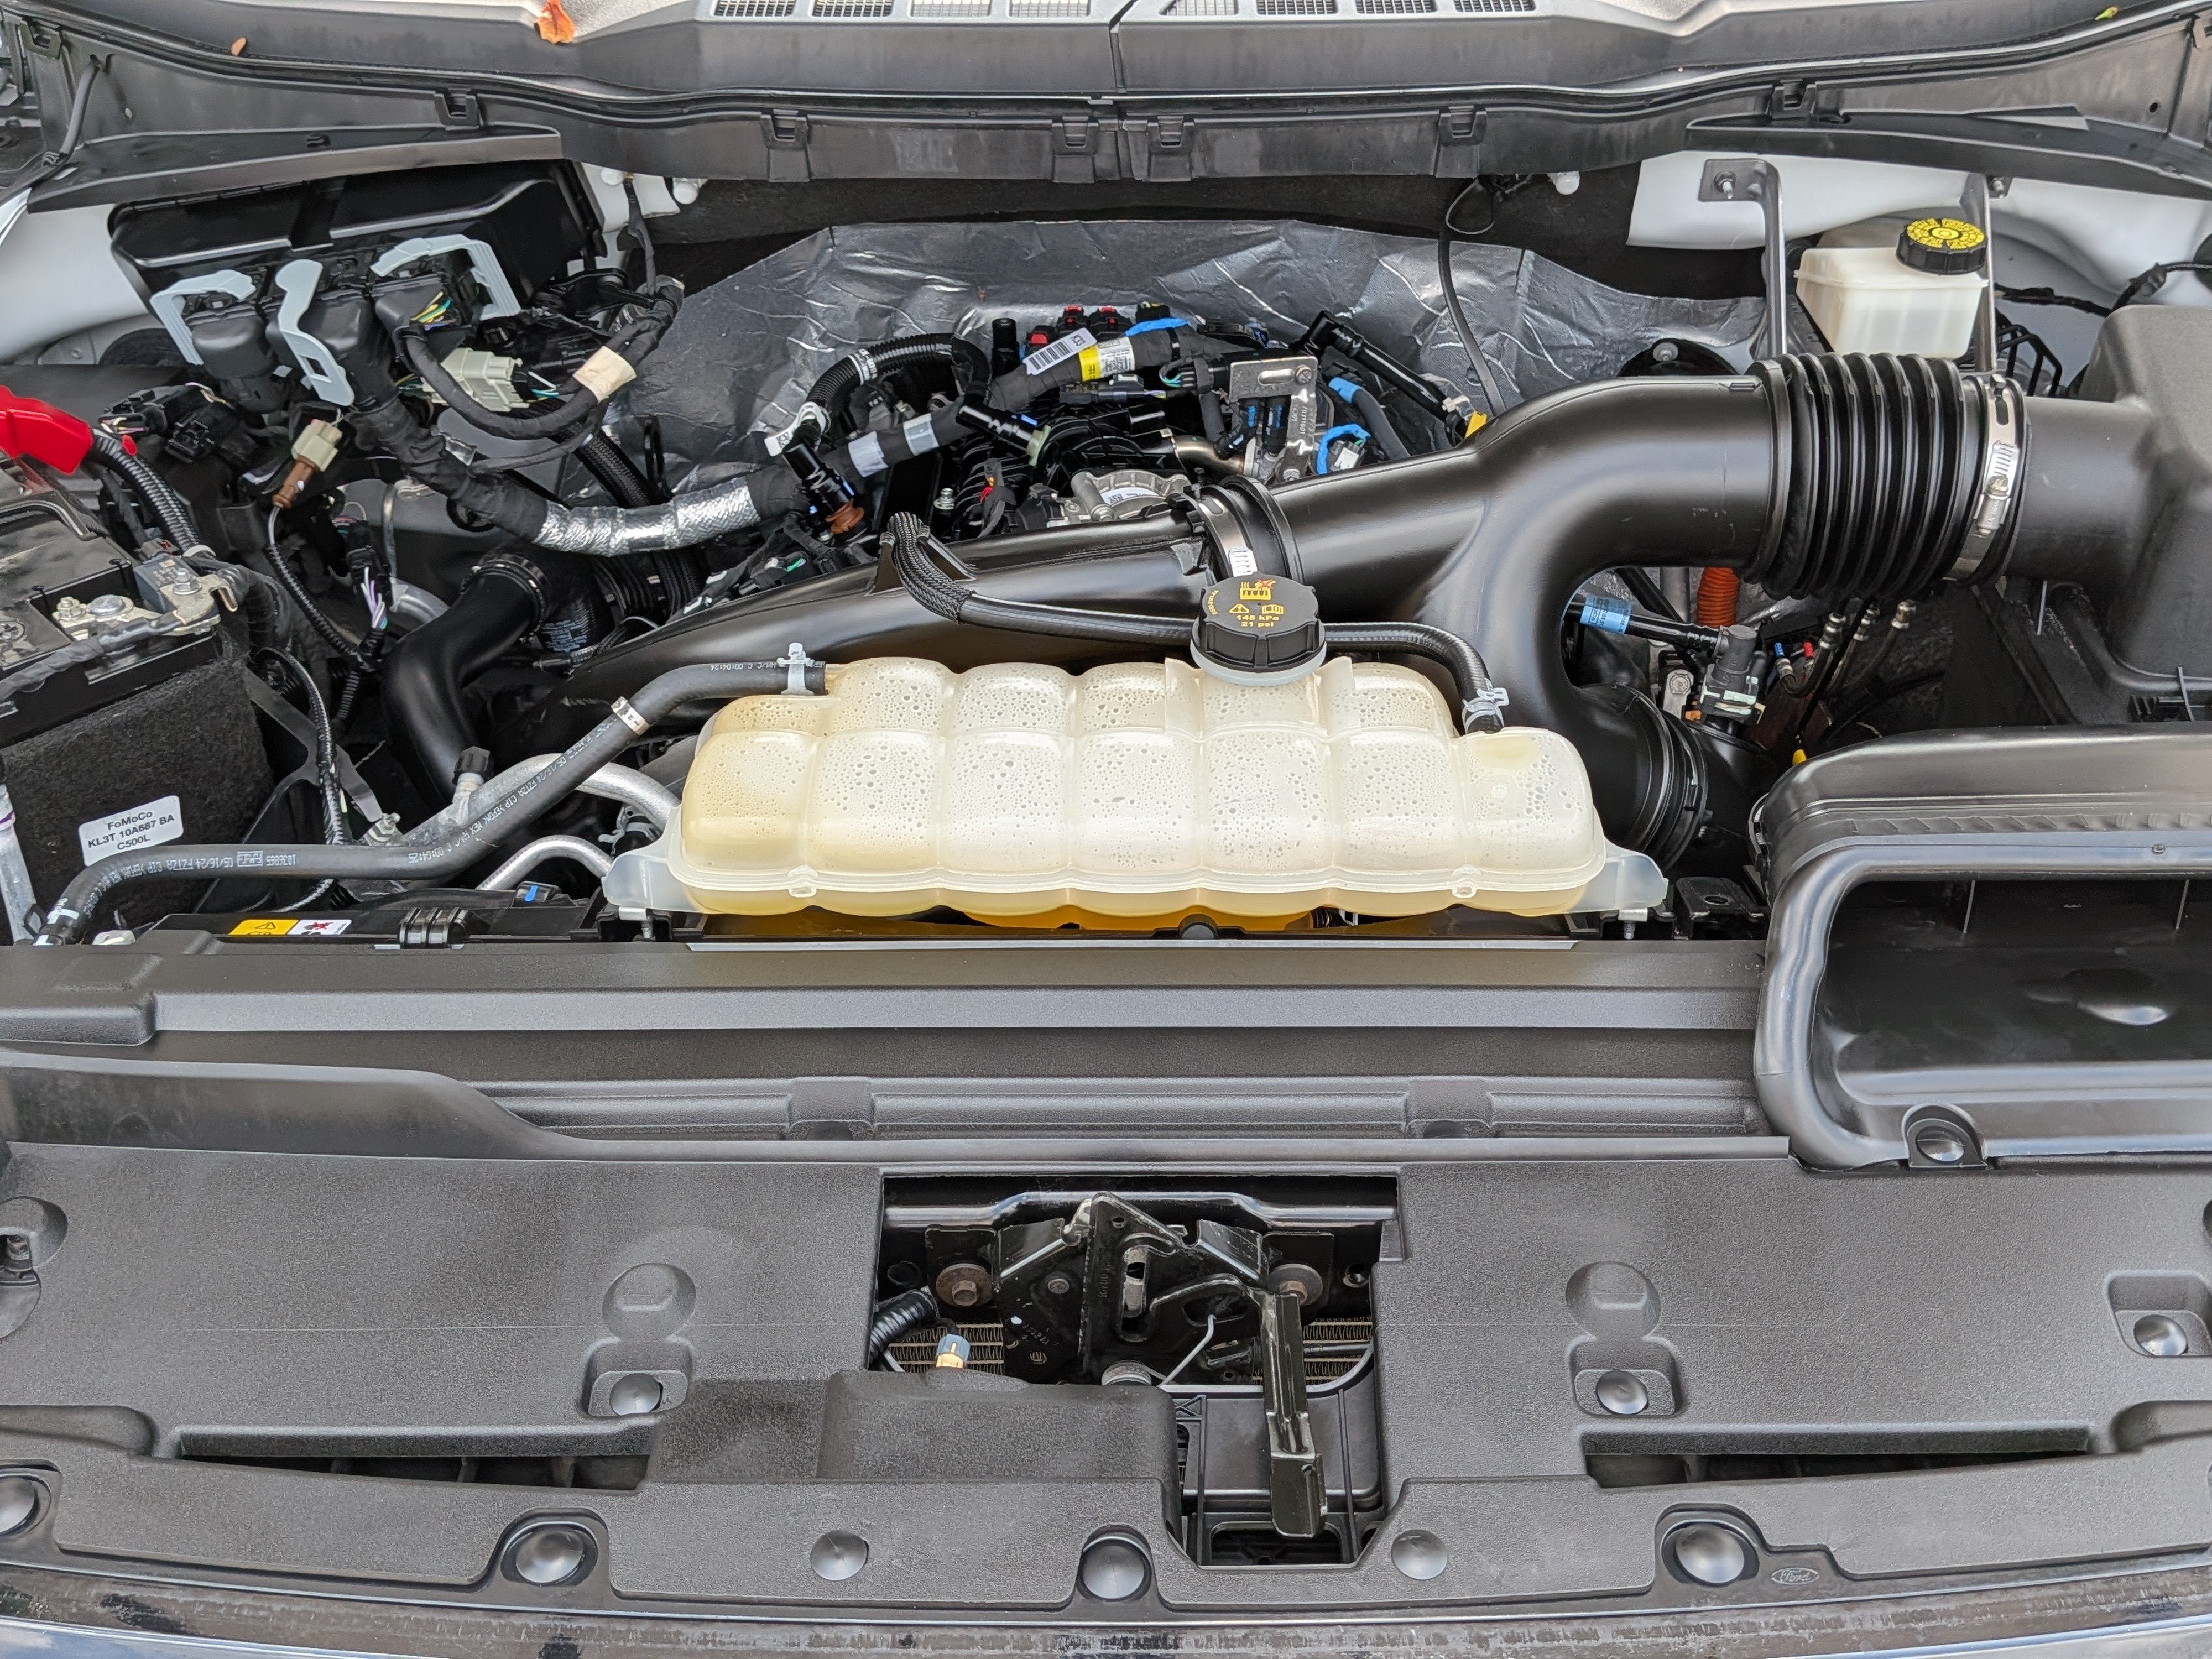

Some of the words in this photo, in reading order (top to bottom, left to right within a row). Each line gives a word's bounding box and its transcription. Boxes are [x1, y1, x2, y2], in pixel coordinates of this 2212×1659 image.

[107, 810, 153, 831] FoMoCo
[87, 833, 117, 849] KL3T
[118, 821, 156, 840] 10A687
[159, 814, 175, 827] BA
[116, 836, 151, 851] C500L
